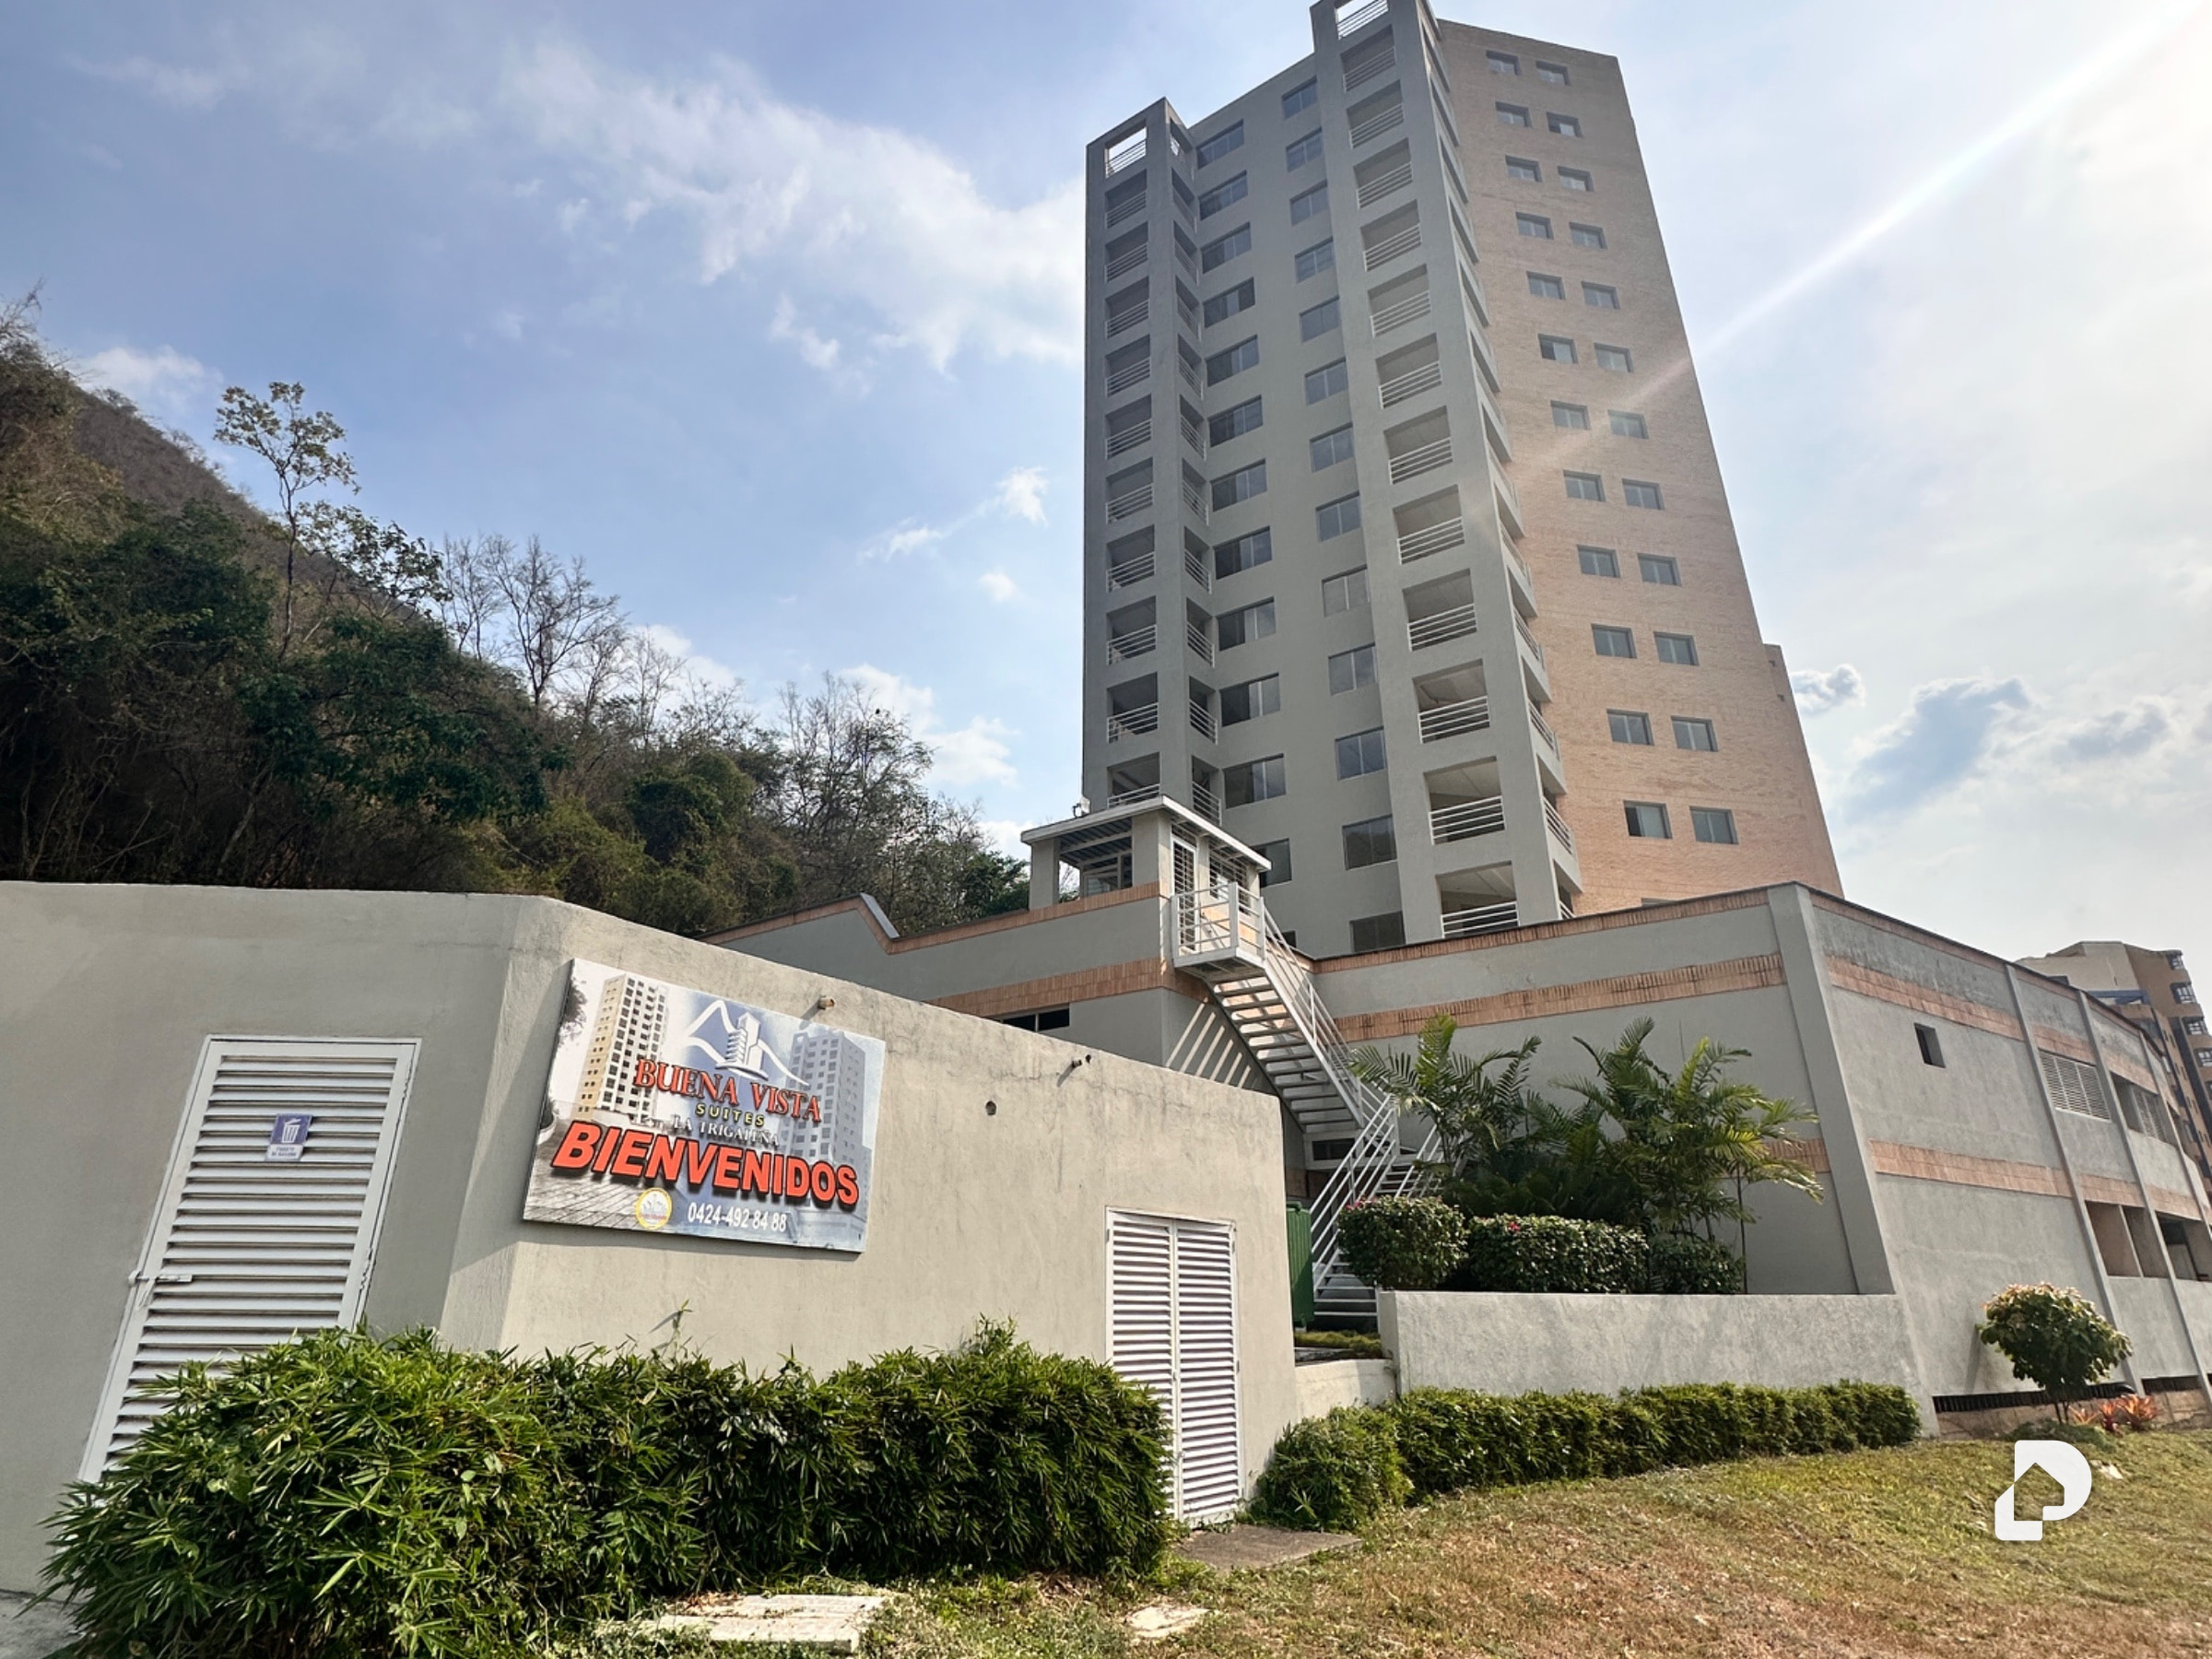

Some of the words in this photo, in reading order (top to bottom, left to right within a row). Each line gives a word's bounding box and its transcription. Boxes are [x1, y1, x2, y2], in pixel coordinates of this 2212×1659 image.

[632, 1059, 739, 1105] BUENA
[750, 1082, 821, 1123] VISTA
[695, 1102, 765, 1126] SUITES
[552, 1120, 860, 1206] BIENVENIDOS
